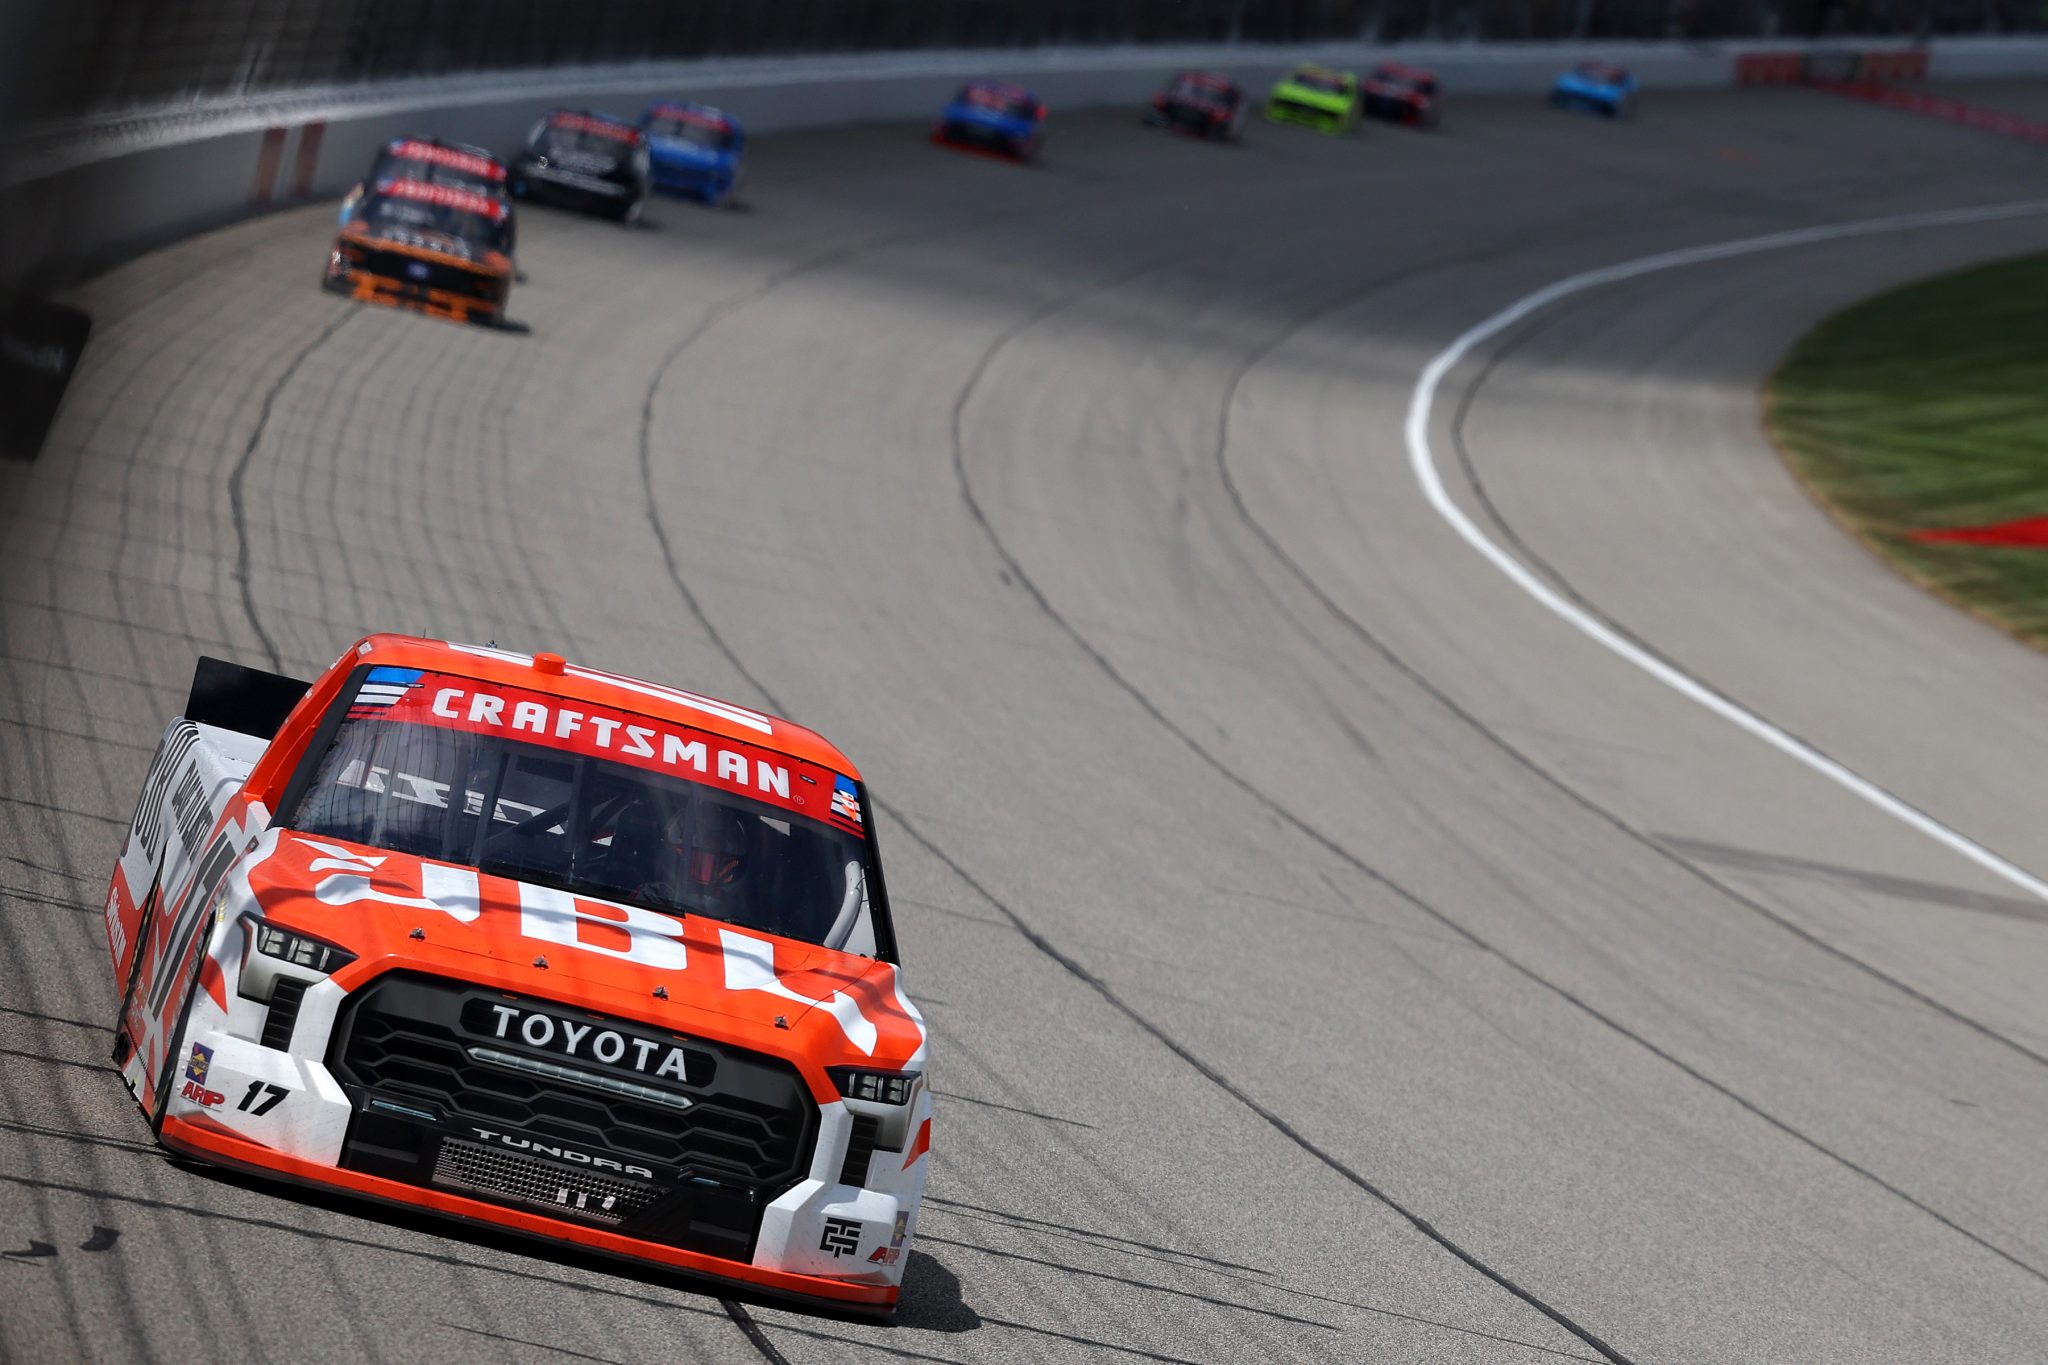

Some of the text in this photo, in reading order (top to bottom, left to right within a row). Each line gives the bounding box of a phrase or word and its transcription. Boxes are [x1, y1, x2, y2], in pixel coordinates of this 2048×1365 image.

[431, 687, 791, 799] CRAFTSMAN
[492, 1004, 688, 1083] TOYOTA
[181, 1080, 225, 1107] ARP
[237, 1080, 290, 1117] 17
[471, 1127, 653, 1179] TUNDRA
